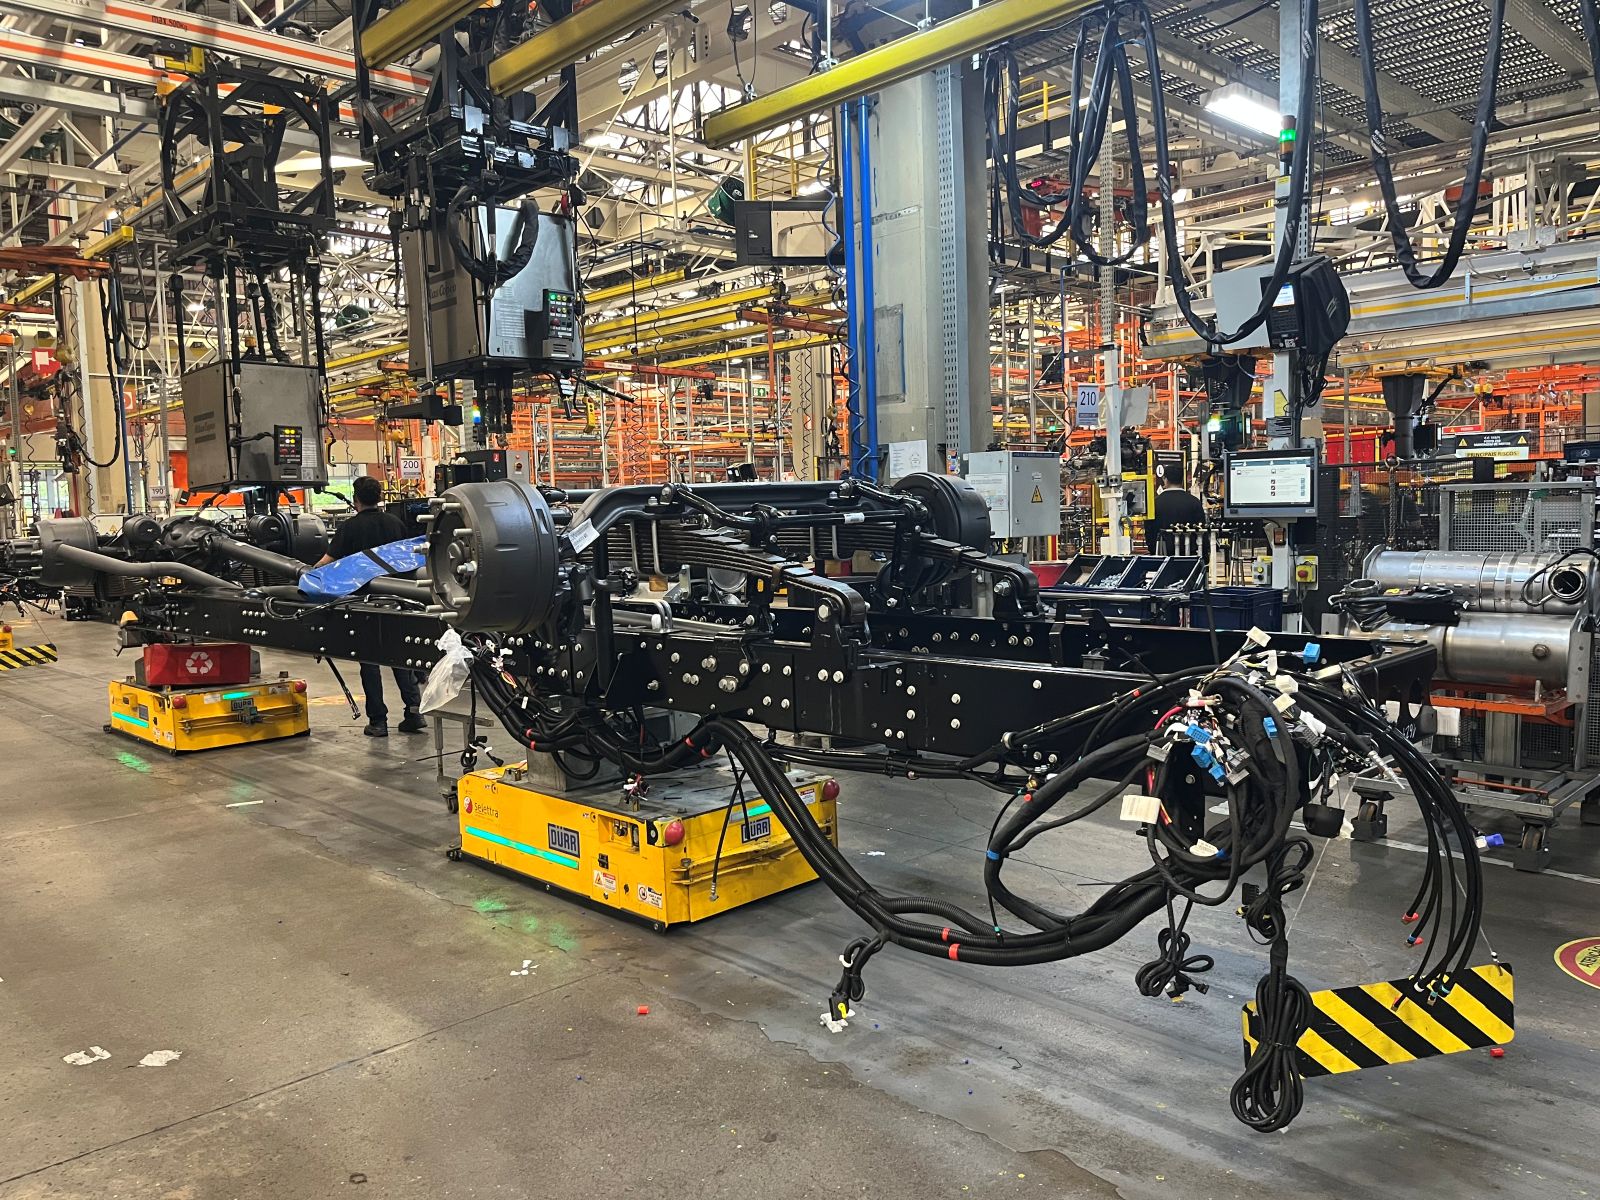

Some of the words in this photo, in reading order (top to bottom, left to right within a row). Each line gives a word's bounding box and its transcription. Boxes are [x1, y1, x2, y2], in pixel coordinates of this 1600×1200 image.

[1080, 391, 1097, 406] 210
[403, 460, 419, 469] 200
[474, 802, 499, 818] Selettra
[550, 825, 577, 852] DÜRR
